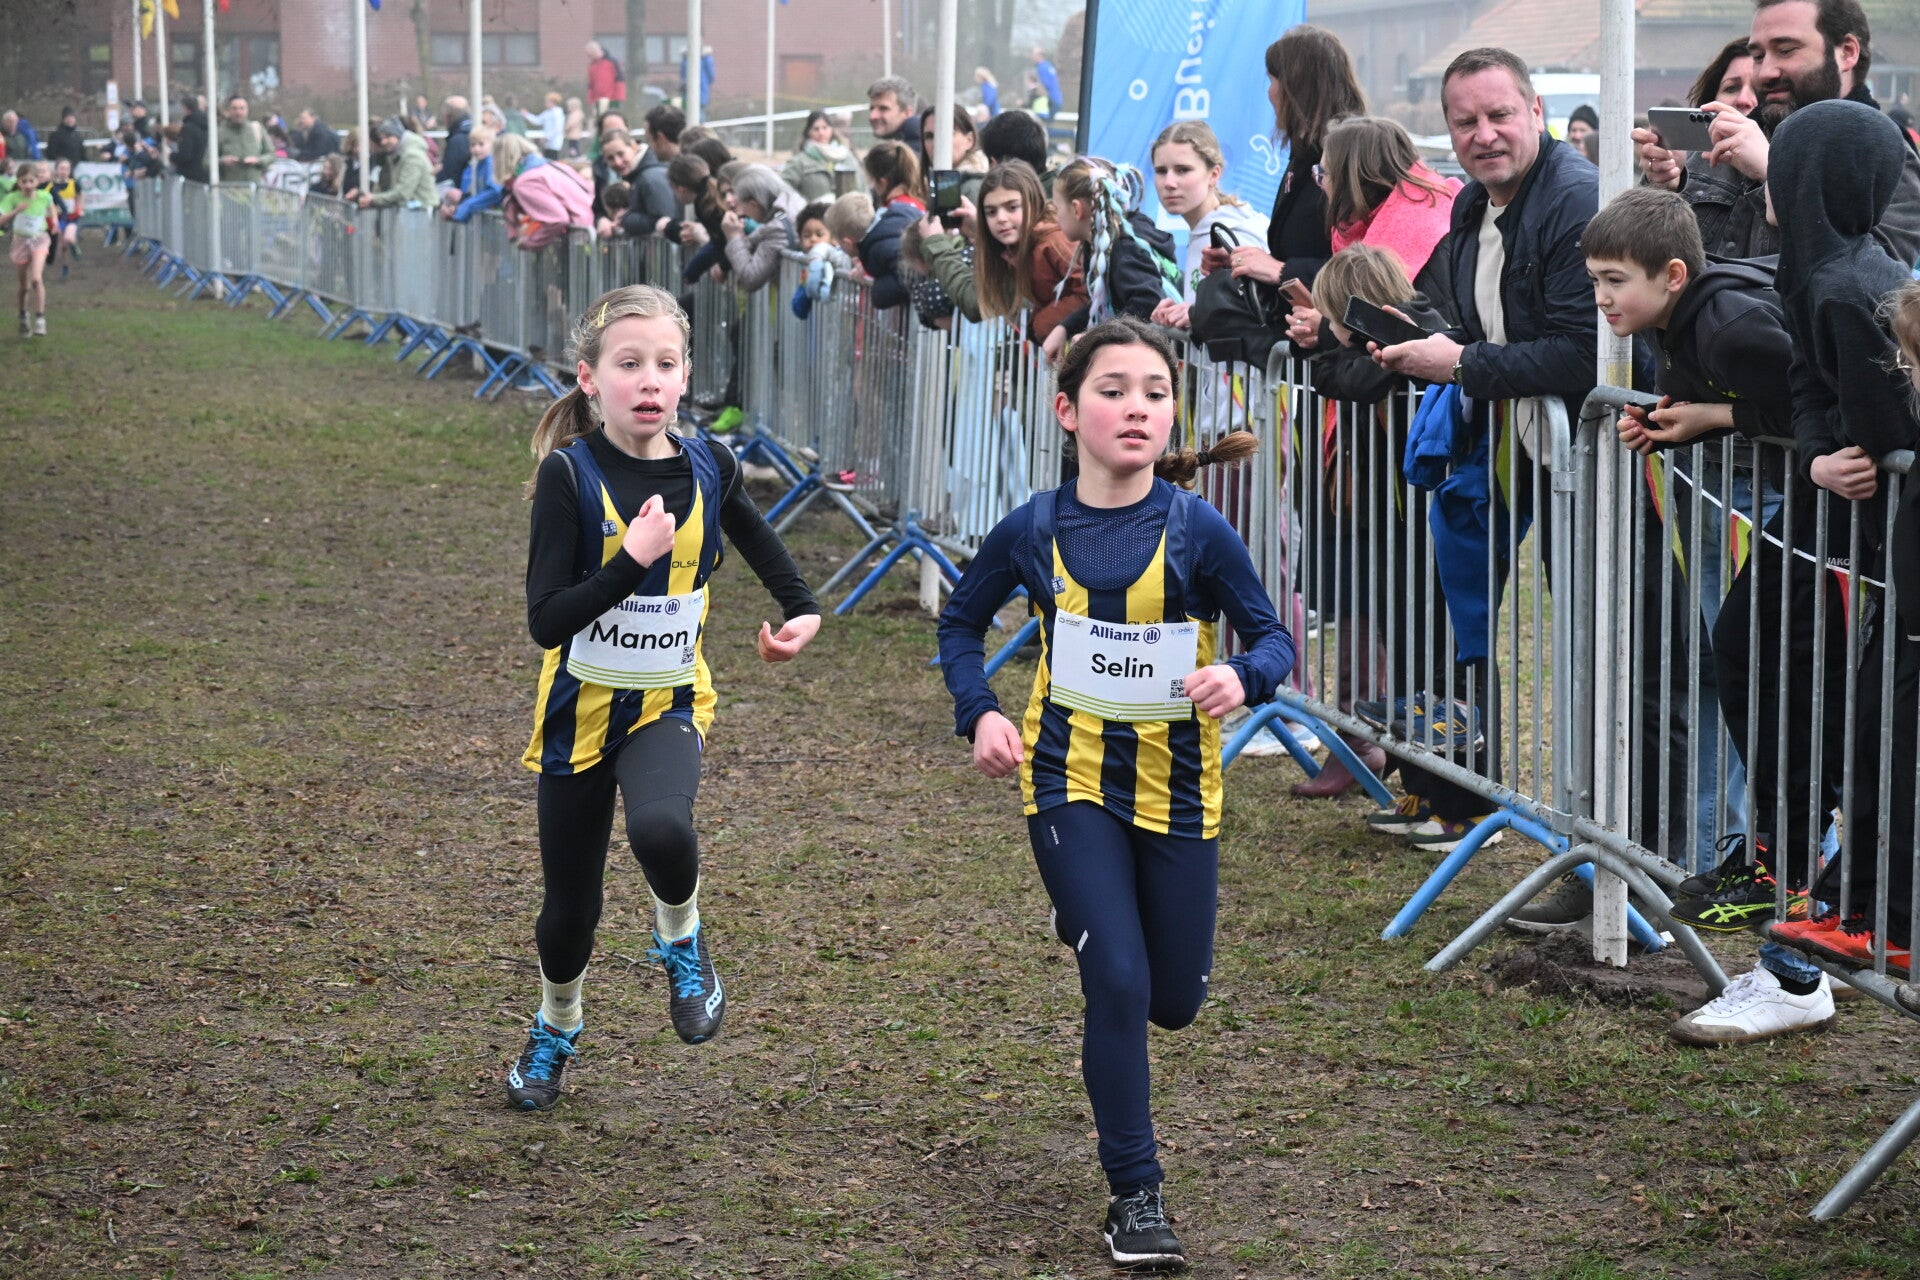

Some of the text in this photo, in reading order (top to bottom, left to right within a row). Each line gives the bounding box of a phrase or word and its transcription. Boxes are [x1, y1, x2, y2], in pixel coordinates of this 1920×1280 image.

[613, 599, 662, 613] Allianz
[589, 620, 688, 650] Manon
[1090, 624, 1140, 642] Allianz
[1091, 653, 1154, 678] Selin
